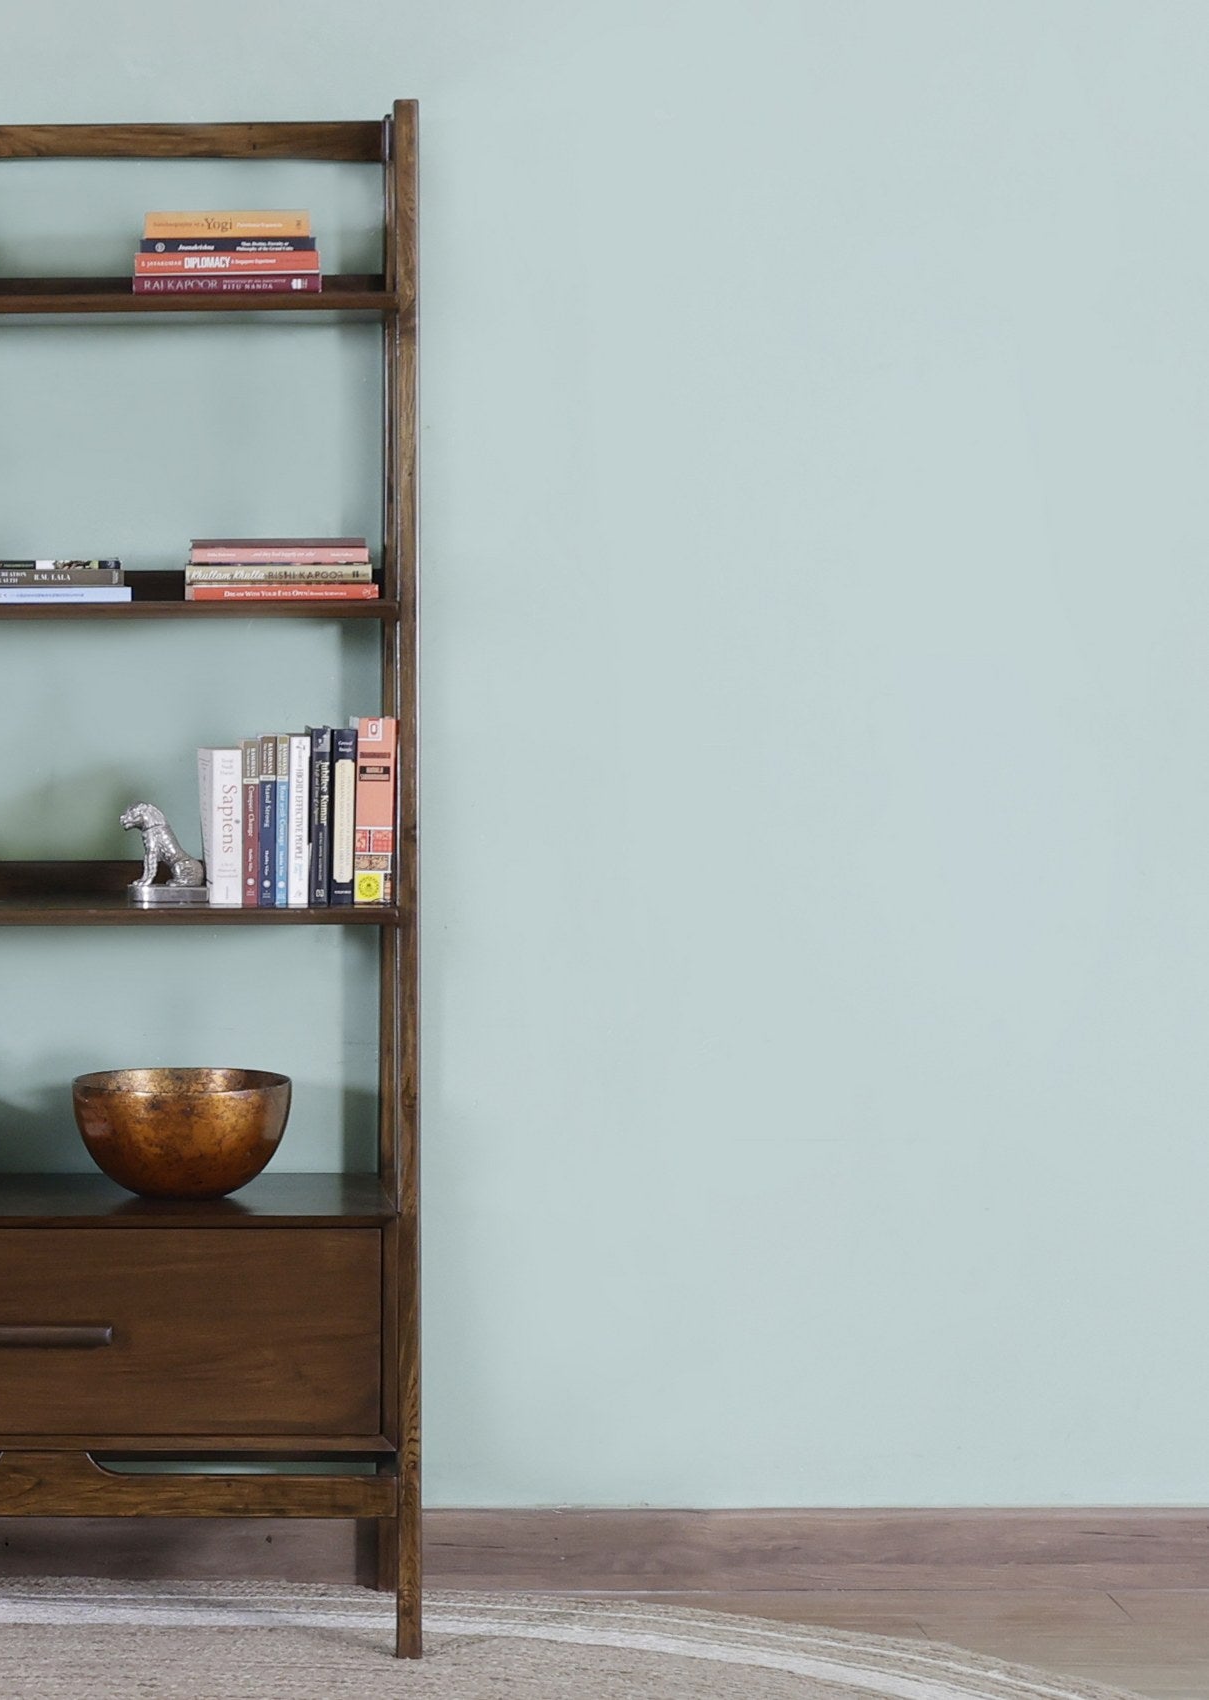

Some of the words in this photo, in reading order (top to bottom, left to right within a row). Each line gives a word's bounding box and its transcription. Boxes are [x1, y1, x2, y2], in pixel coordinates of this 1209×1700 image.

[204, 217, 233, 233] Yogi
[184, 256, 231, 269] DIPLOMACY
[144, 280, 164, 291] RAJ
[167, 279, 218, 291] KAPOOR
[51, 573, 71, 581] LALA
[268, 571, 295, 579] RISHI
[299, 571, 343, 579] KAPOOR
[295, 769, 303, 793] HIGHLY
[320, 761, 330, 792] Jubilee
[217, 784, 239, 853] Sapiens
[263, 805, 271, 828] Strong
[294, 795, 303, 833] EFFECTIVE
[319, 795, 330, 826] Kumar
[294, 835, 303, 861] PEOPLE
